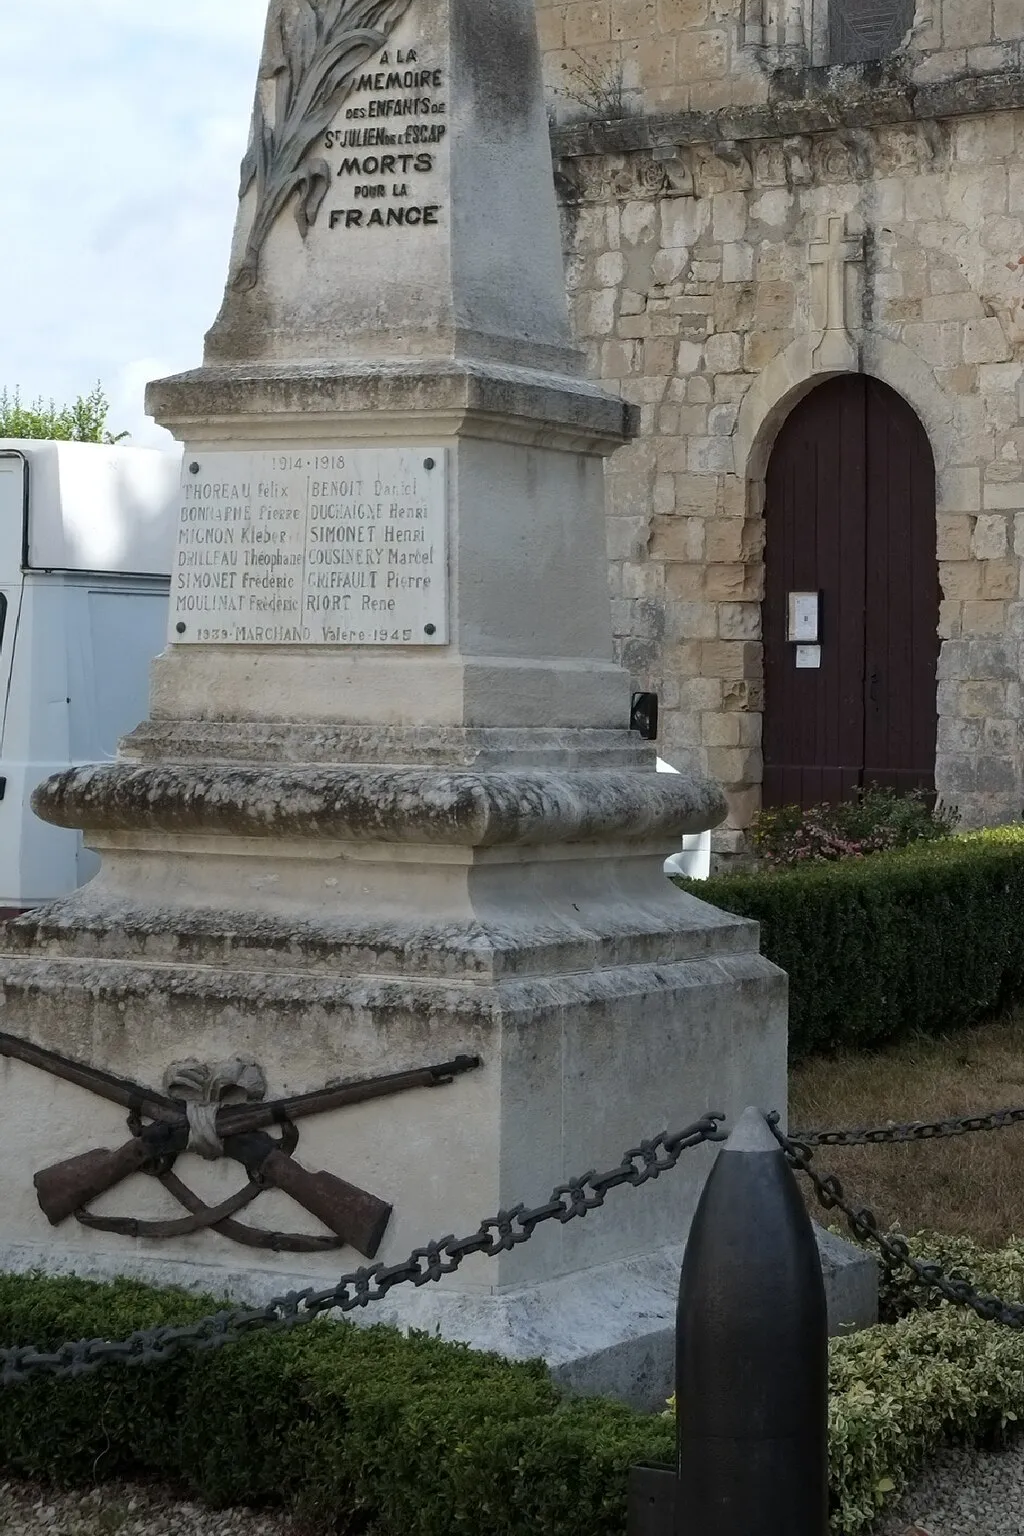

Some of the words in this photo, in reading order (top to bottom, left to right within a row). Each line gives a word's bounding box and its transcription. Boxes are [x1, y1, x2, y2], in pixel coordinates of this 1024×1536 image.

[380, 50, 388, 64] A
[397, 49, 416, 63] LA
[356, 69, 441, 91] MEMOIRE
[346, 108, 366, 119] DES
[369, 98, 431, 117] ENFANTS
[431, 103, 445, 113] DE
[340, 127, 385, 147] JULIEN
[337, 153, 432, 176] MORTS
[354, 184, 385, 198] POUR
[393, 184, 407, 196] LA
[329, 205, 438, 229] FRANCE
[182, 483, 251, 499] THOREAU
[312, 481, 363, 497] BENOIT
[179, 527, 233, 544] MIGNON
[311, 526, 376, 542] SIMONET
[388, 544, 433, 564] Marcel
[177, 572, 238, 589] SIMONET
[176, 595, 245, 611] MOULINAT
[236, 627, 310, 641] MARCHAND
